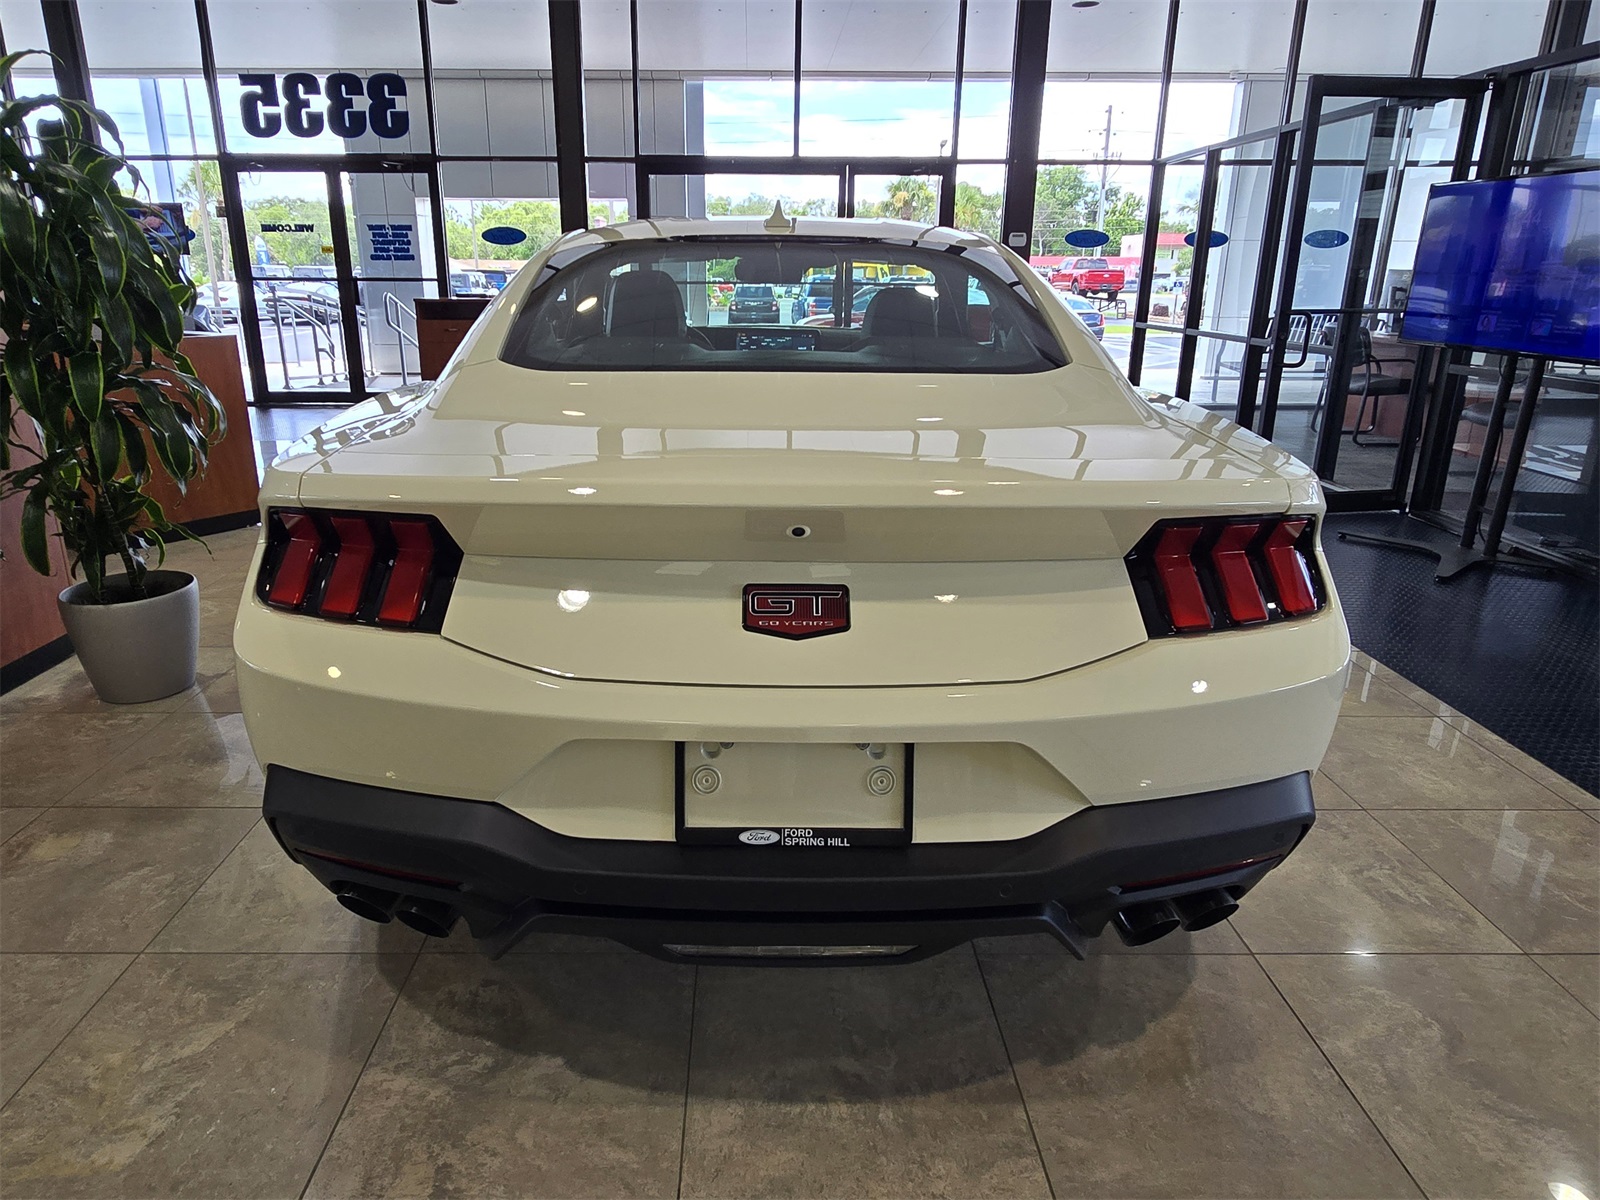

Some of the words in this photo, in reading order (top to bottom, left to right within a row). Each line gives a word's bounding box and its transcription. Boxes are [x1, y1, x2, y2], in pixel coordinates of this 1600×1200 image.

[749, 590, 843, 616] GT
[746, 831, 772, 842] Ford
[784, 828, 813, 837] FORD
[784, 837, 825, 846] SPRING
[827, 837, 851, 847] HILL
